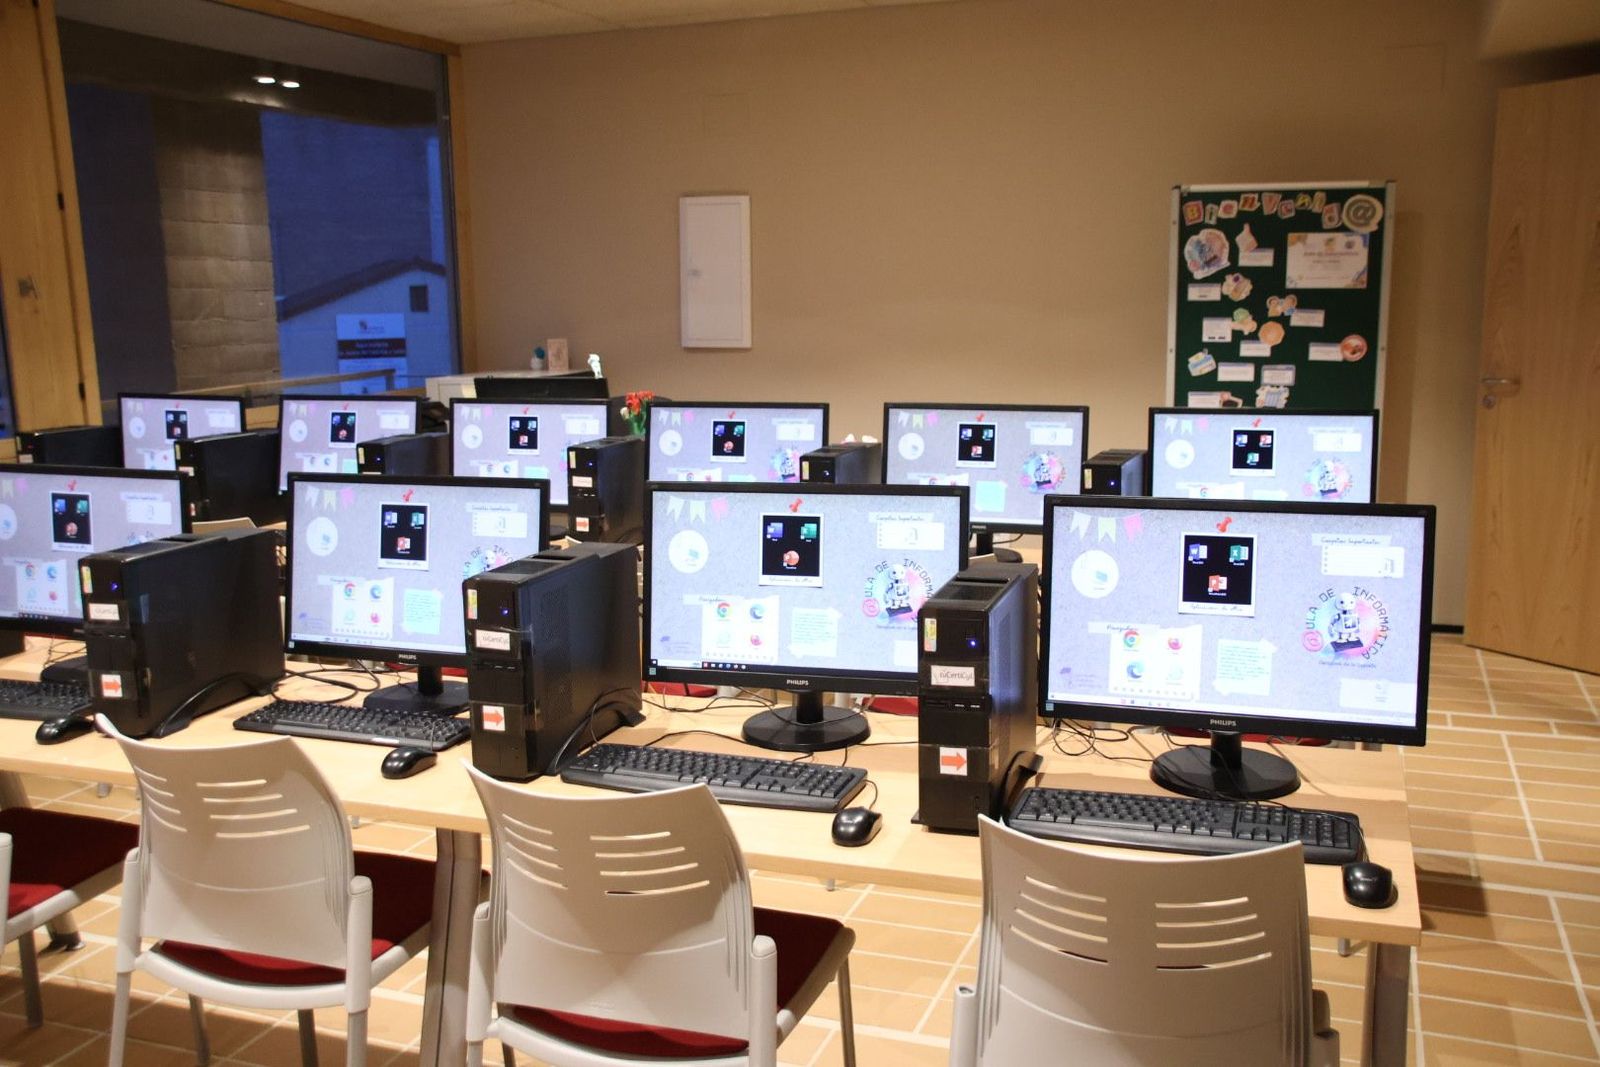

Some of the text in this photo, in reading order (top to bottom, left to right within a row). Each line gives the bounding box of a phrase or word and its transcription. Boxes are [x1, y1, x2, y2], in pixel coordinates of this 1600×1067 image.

[874, 560, 889, 574] DE
[1318, 588, 1337, 603] DE
[1209, 718, 1237, 727] PHILIPS
